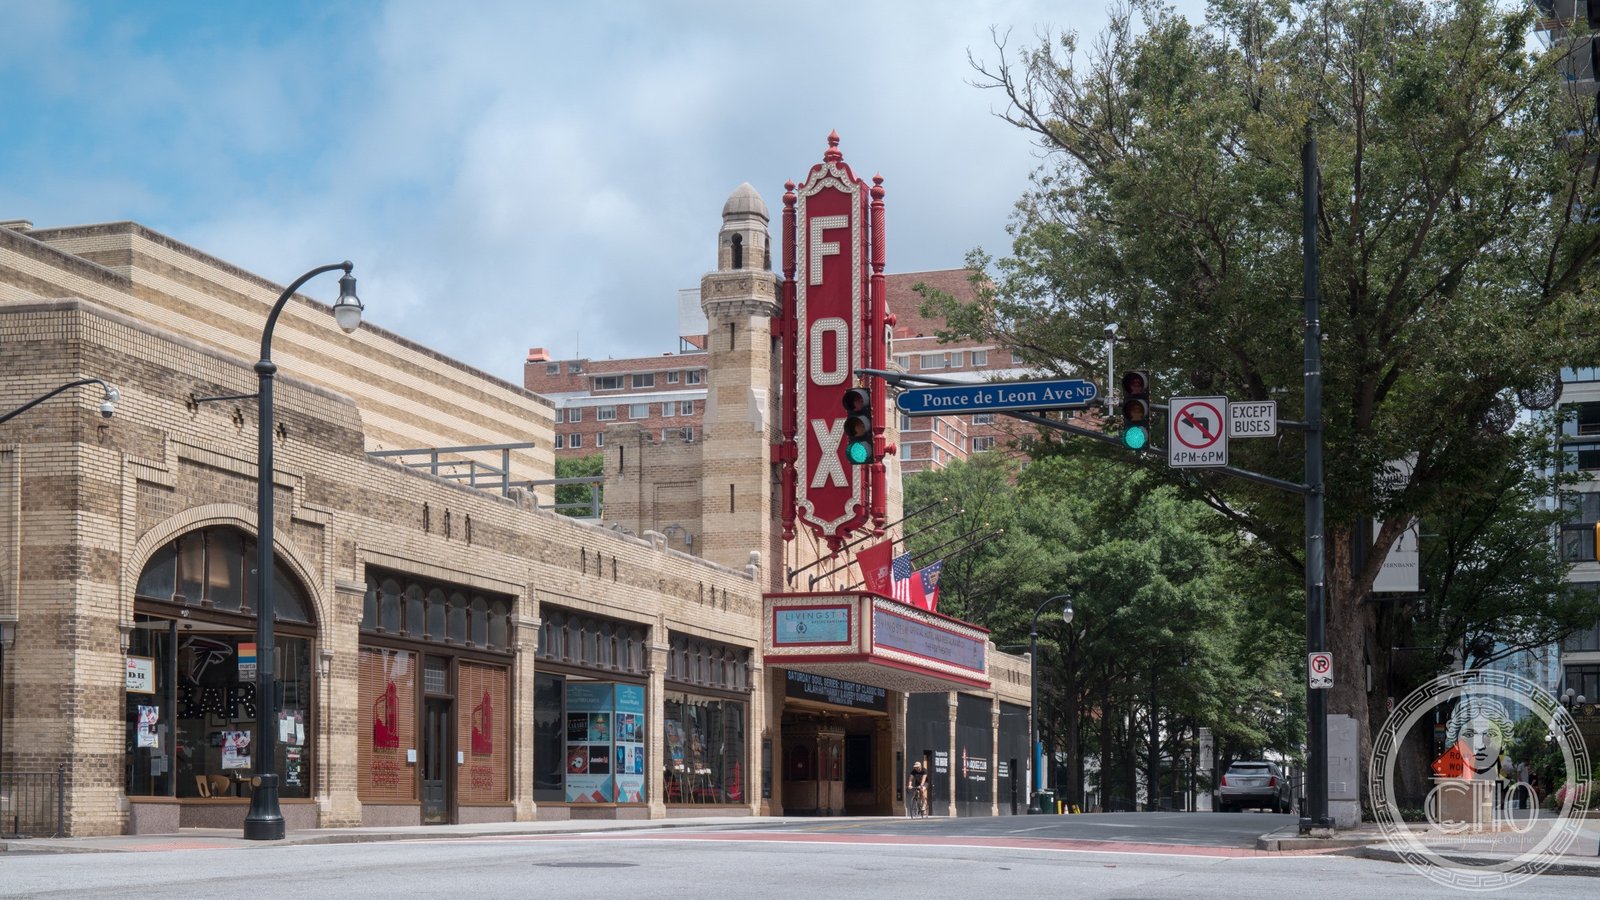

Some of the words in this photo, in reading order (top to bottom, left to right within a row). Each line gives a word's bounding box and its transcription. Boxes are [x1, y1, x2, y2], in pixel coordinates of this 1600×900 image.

[810, 214, 849, 488] FOX
[922, 392, 971, 407] Ponce
[974, 389, 992, 404] de
[998, 387, 1037, 403] Leon
[1042, 385, 1073, 400] Ave
[1076, 386, 1093, 397] NE
[1232, 405, 1273, 419] EXCEPT
[1235, 419, 1270, 433] BUSES
[1173, 451, 1224, 463] 4PM-6PM
[176, 682, 256, 719] BAR
